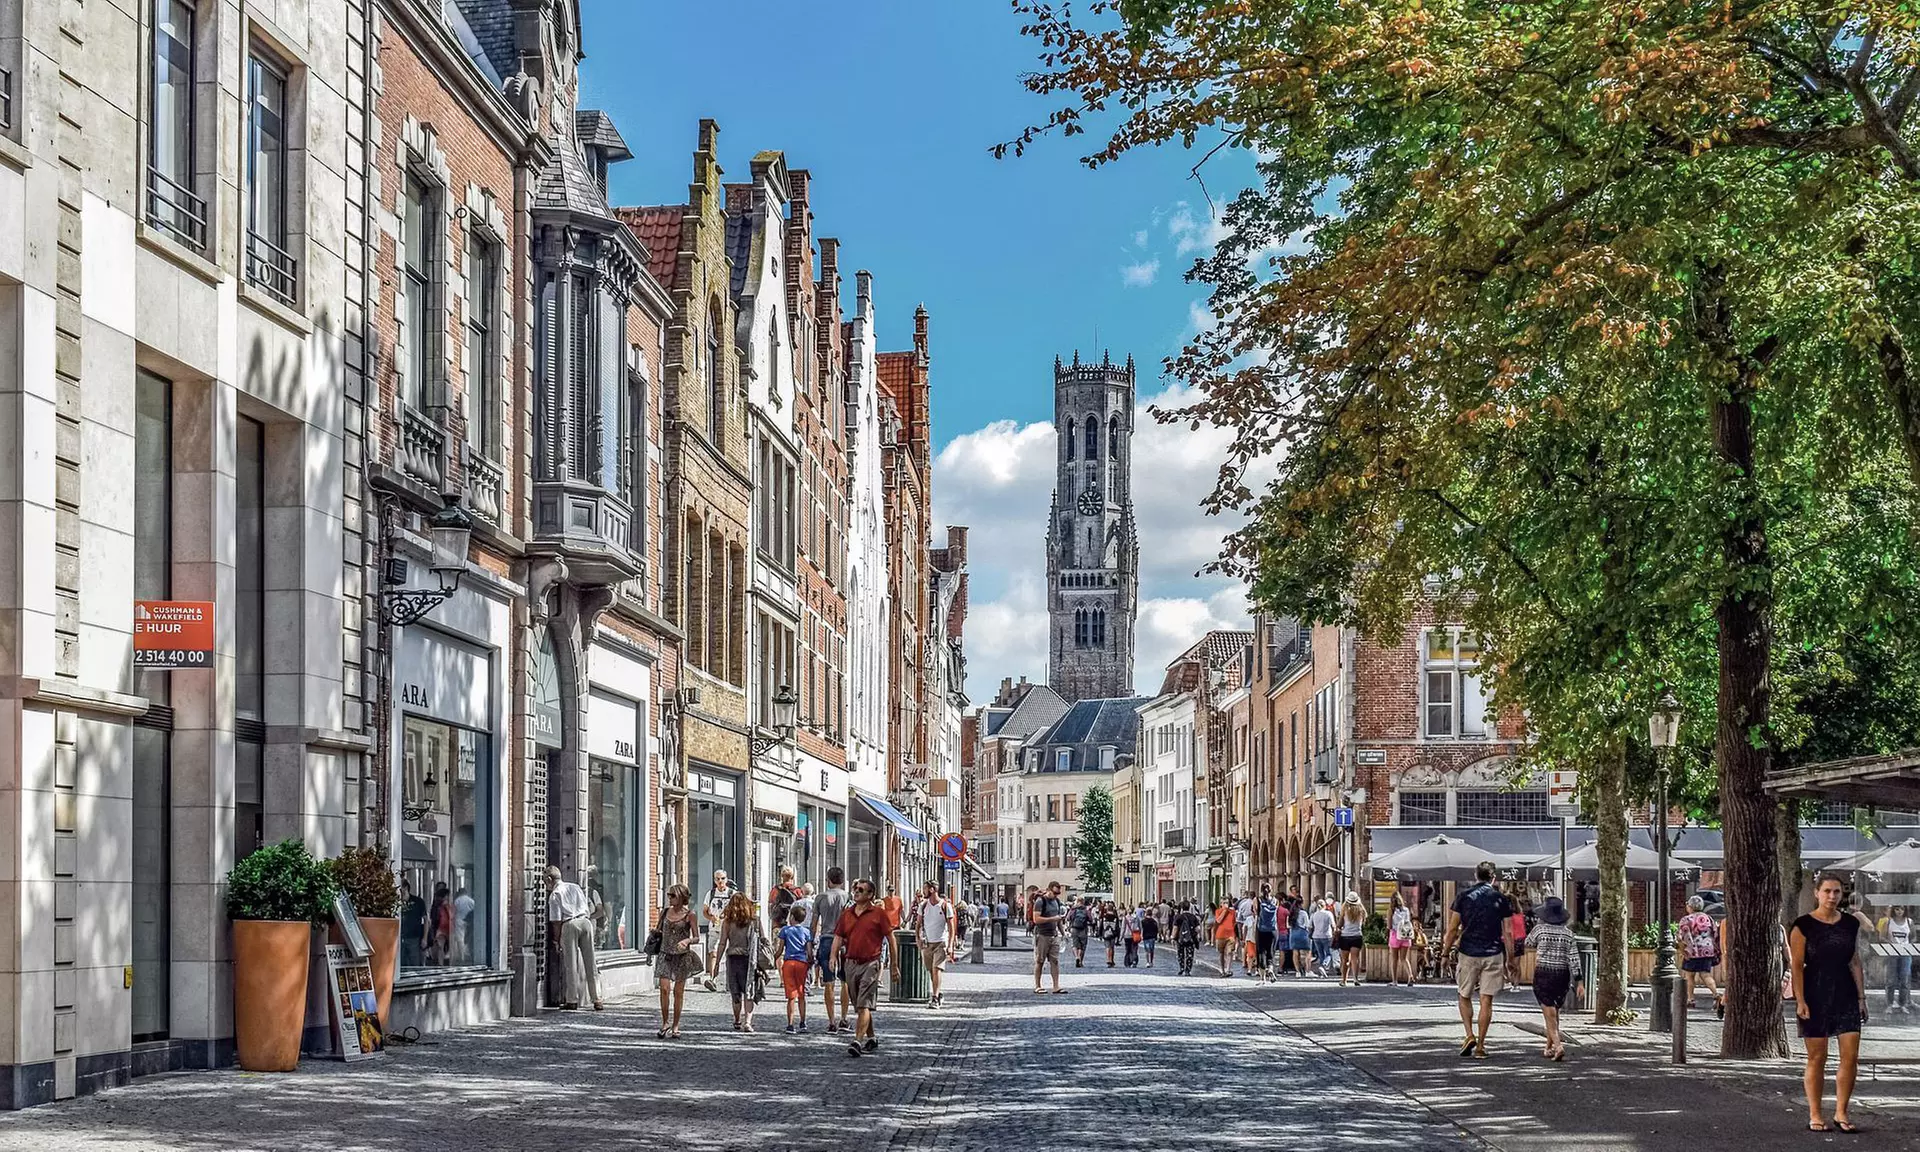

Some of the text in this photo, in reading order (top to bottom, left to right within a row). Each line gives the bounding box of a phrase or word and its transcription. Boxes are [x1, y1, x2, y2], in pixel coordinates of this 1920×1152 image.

[135, 623, 182, 633] E HUUR
[136, 650, 204, 662] 2 514 40 00
[402, 683, 429, 708] ARA
[535, 714, 553, 734] ARA
[615, 740, 634, 759] ZARA
